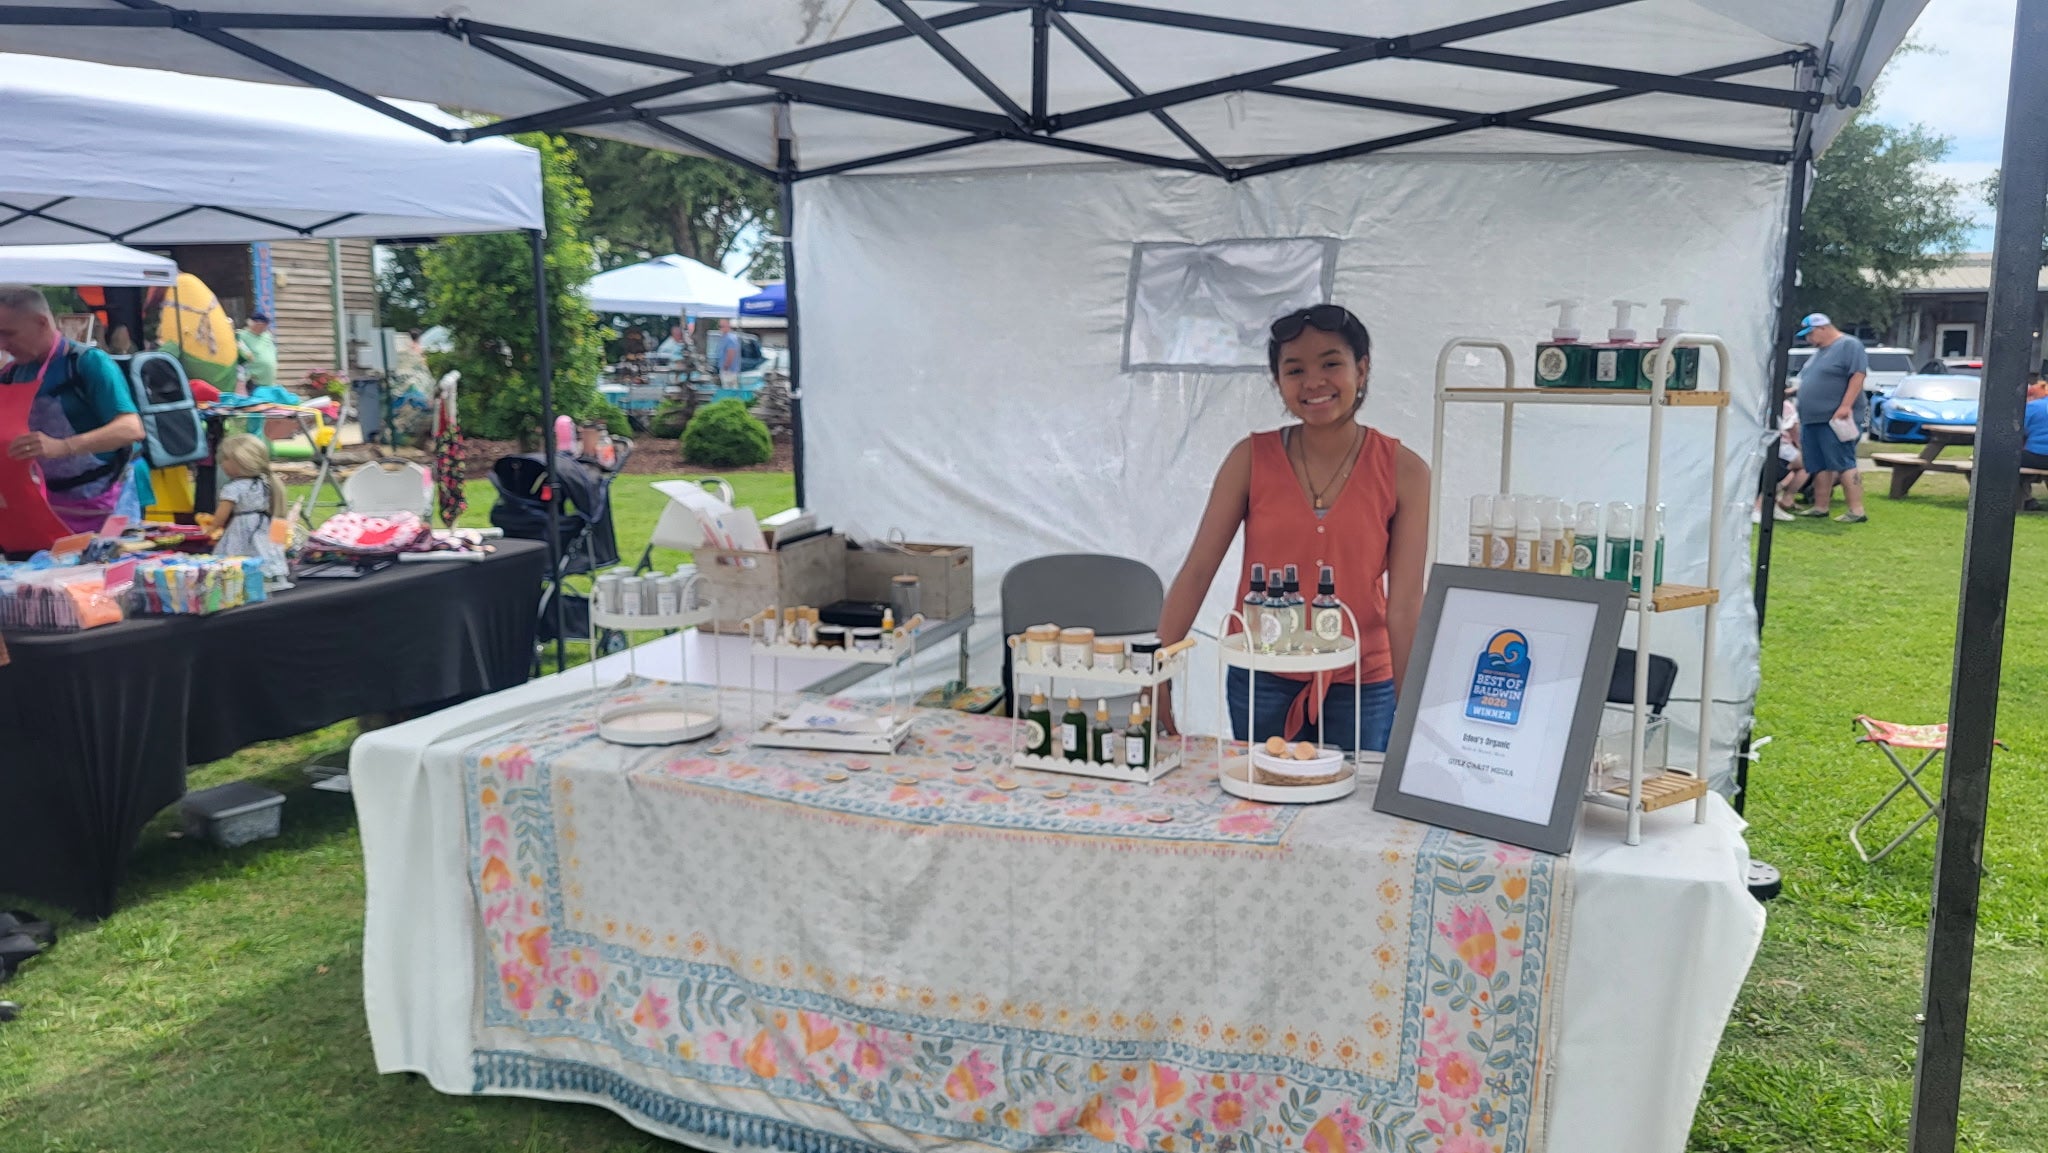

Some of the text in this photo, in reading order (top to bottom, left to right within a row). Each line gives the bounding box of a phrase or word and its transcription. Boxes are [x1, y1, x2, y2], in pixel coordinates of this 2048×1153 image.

[1476, 673, 1505, 688] BEST
[1506, 678, 1524, 690] OF
[1473, 684, 1522, 700] BALDWIN
[1473, 706, 1512, 720] WINNER
[1485, 737, 1511, 749] Organic
